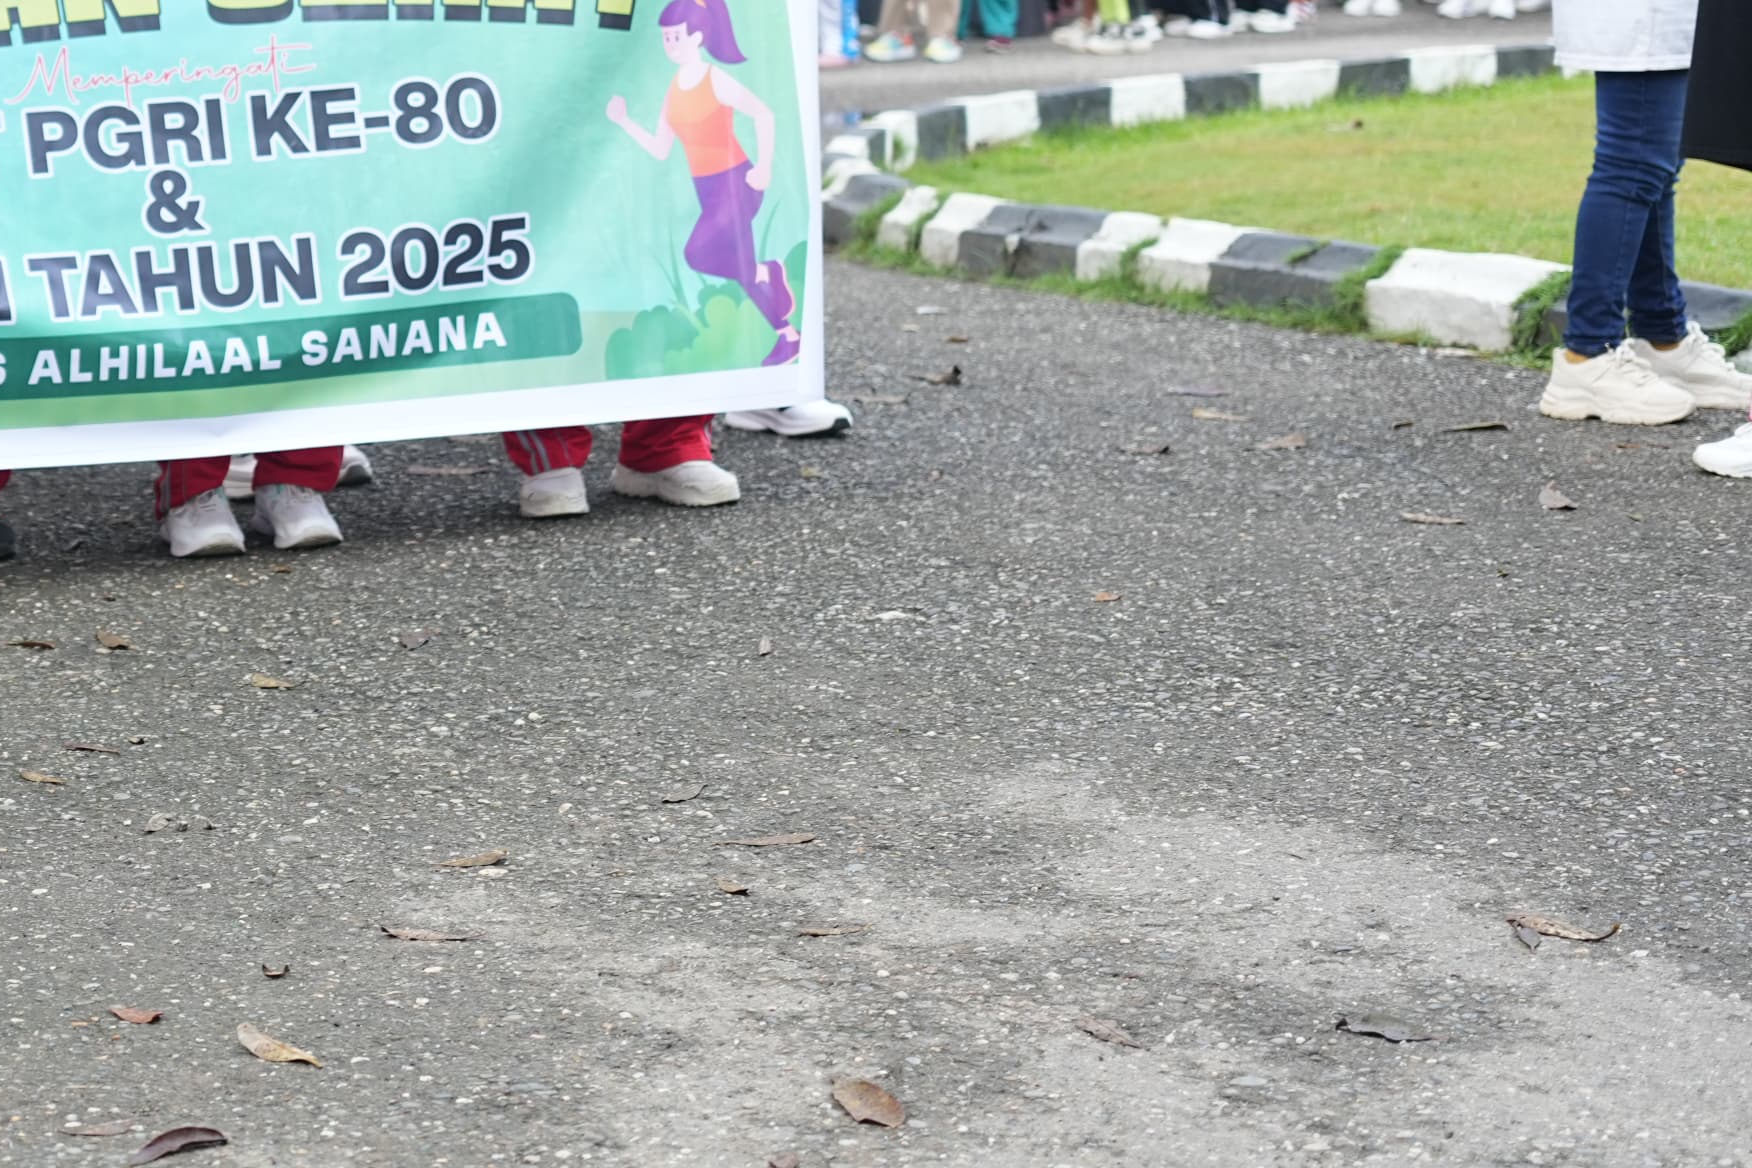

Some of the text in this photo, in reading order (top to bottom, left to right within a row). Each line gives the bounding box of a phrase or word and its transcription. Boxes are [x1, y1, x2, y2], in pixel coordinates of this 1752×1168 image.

[5, 35, 317, 108] Memperingati
[24, 98, 229, 175] PGRI
[249, 76, 498, 158] KE-80
[146, 168, 205, 233] &
[28, 236, 318, 318] TAHUN
[342, 215, 531, 296] 2025
[27, 334, 283, 386] ALHILAAL
[301, 312, 508, 367] SANANA
